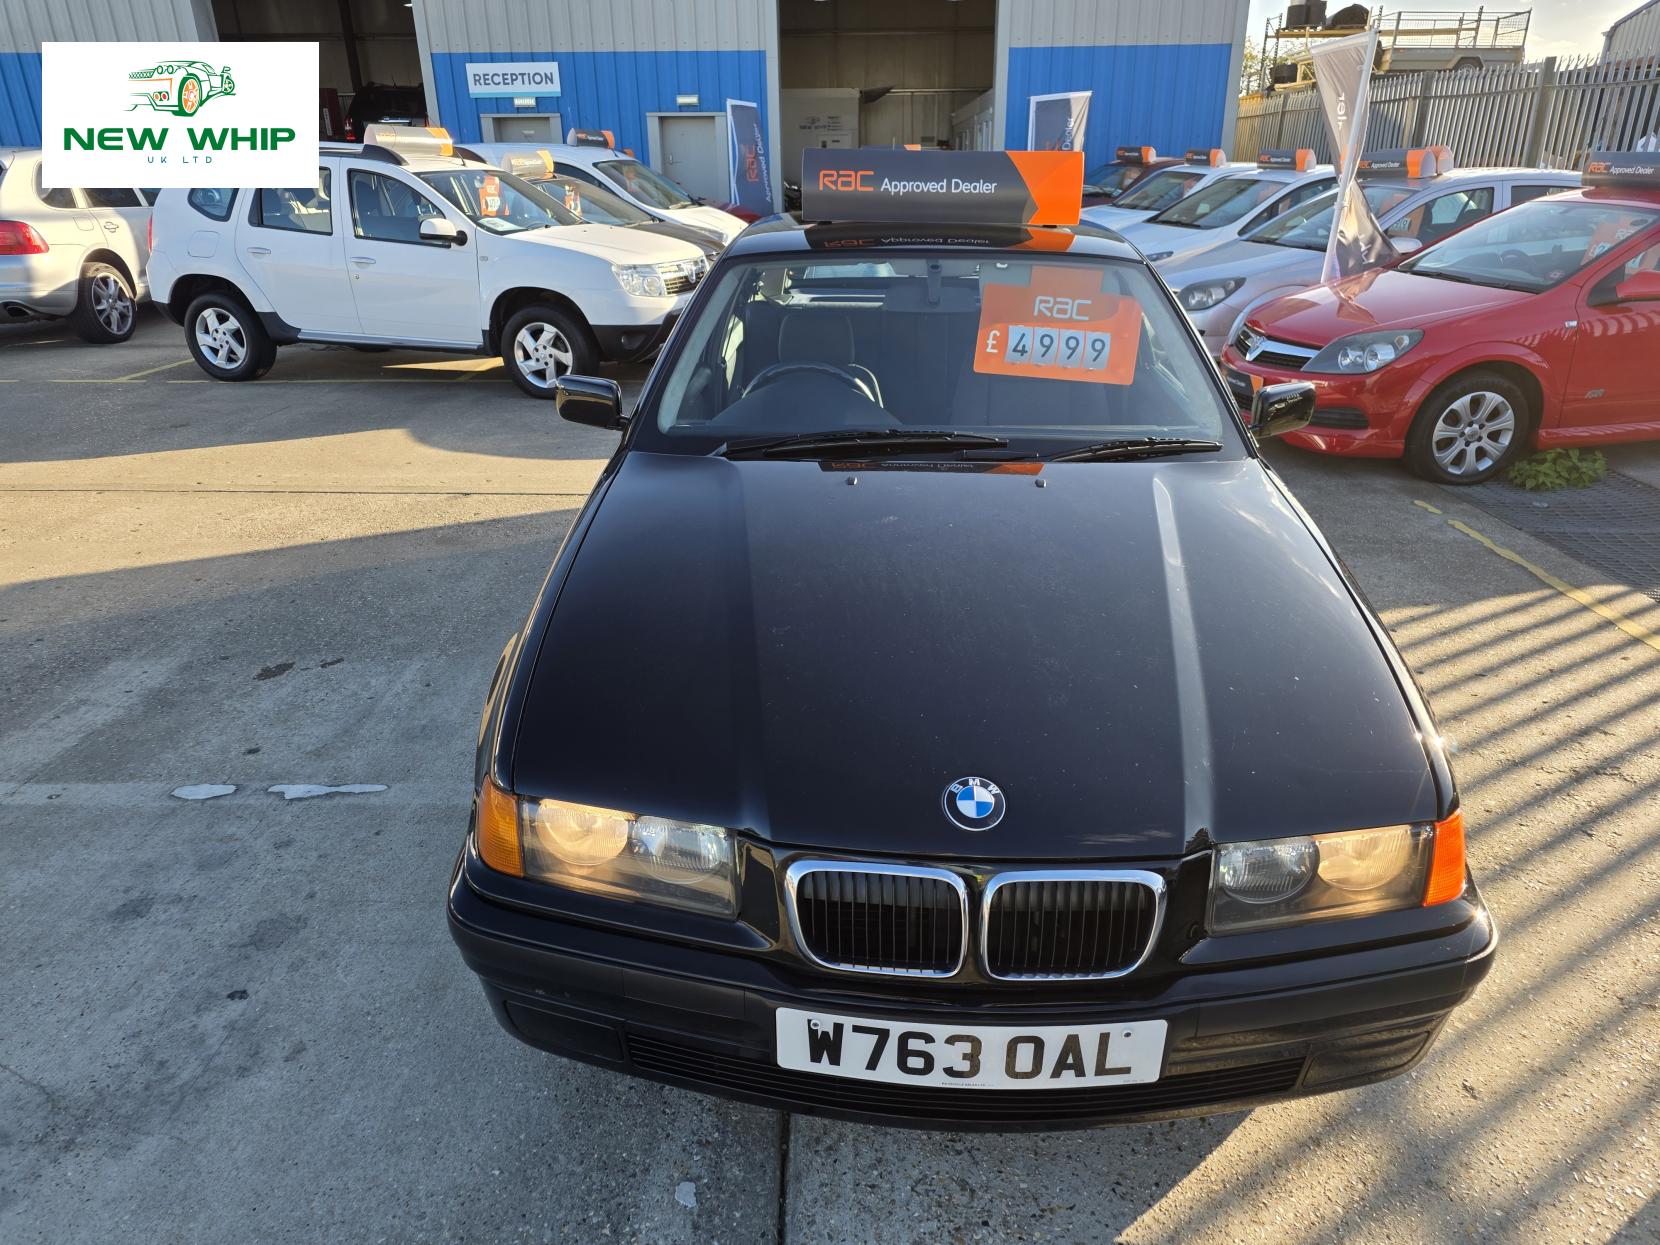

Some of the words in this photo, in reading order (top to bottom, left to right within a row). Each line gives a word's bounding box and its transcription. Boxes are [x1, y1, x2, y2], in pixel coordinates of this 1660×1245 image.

[473, 72, 554, 86] RECEPTION
[1062, 118, 1074, 150] Dealer
[818, 170, 874, 191] RAC
[880, 177, 946, 195] Approved
[951, 178, 997, 194] Dealer
[1610, 166, 1635, 175] Approved
[1635, 166, 1654, 175] Dealer
[1034, 295, 1092, 320] RAC
[1012, 332, 1106, 362] 4999
[950, 778, 1000, 795] BMW
[807, 1018, 983, 1079] W763
[1005, 1031, 1132, 1080] OAL
